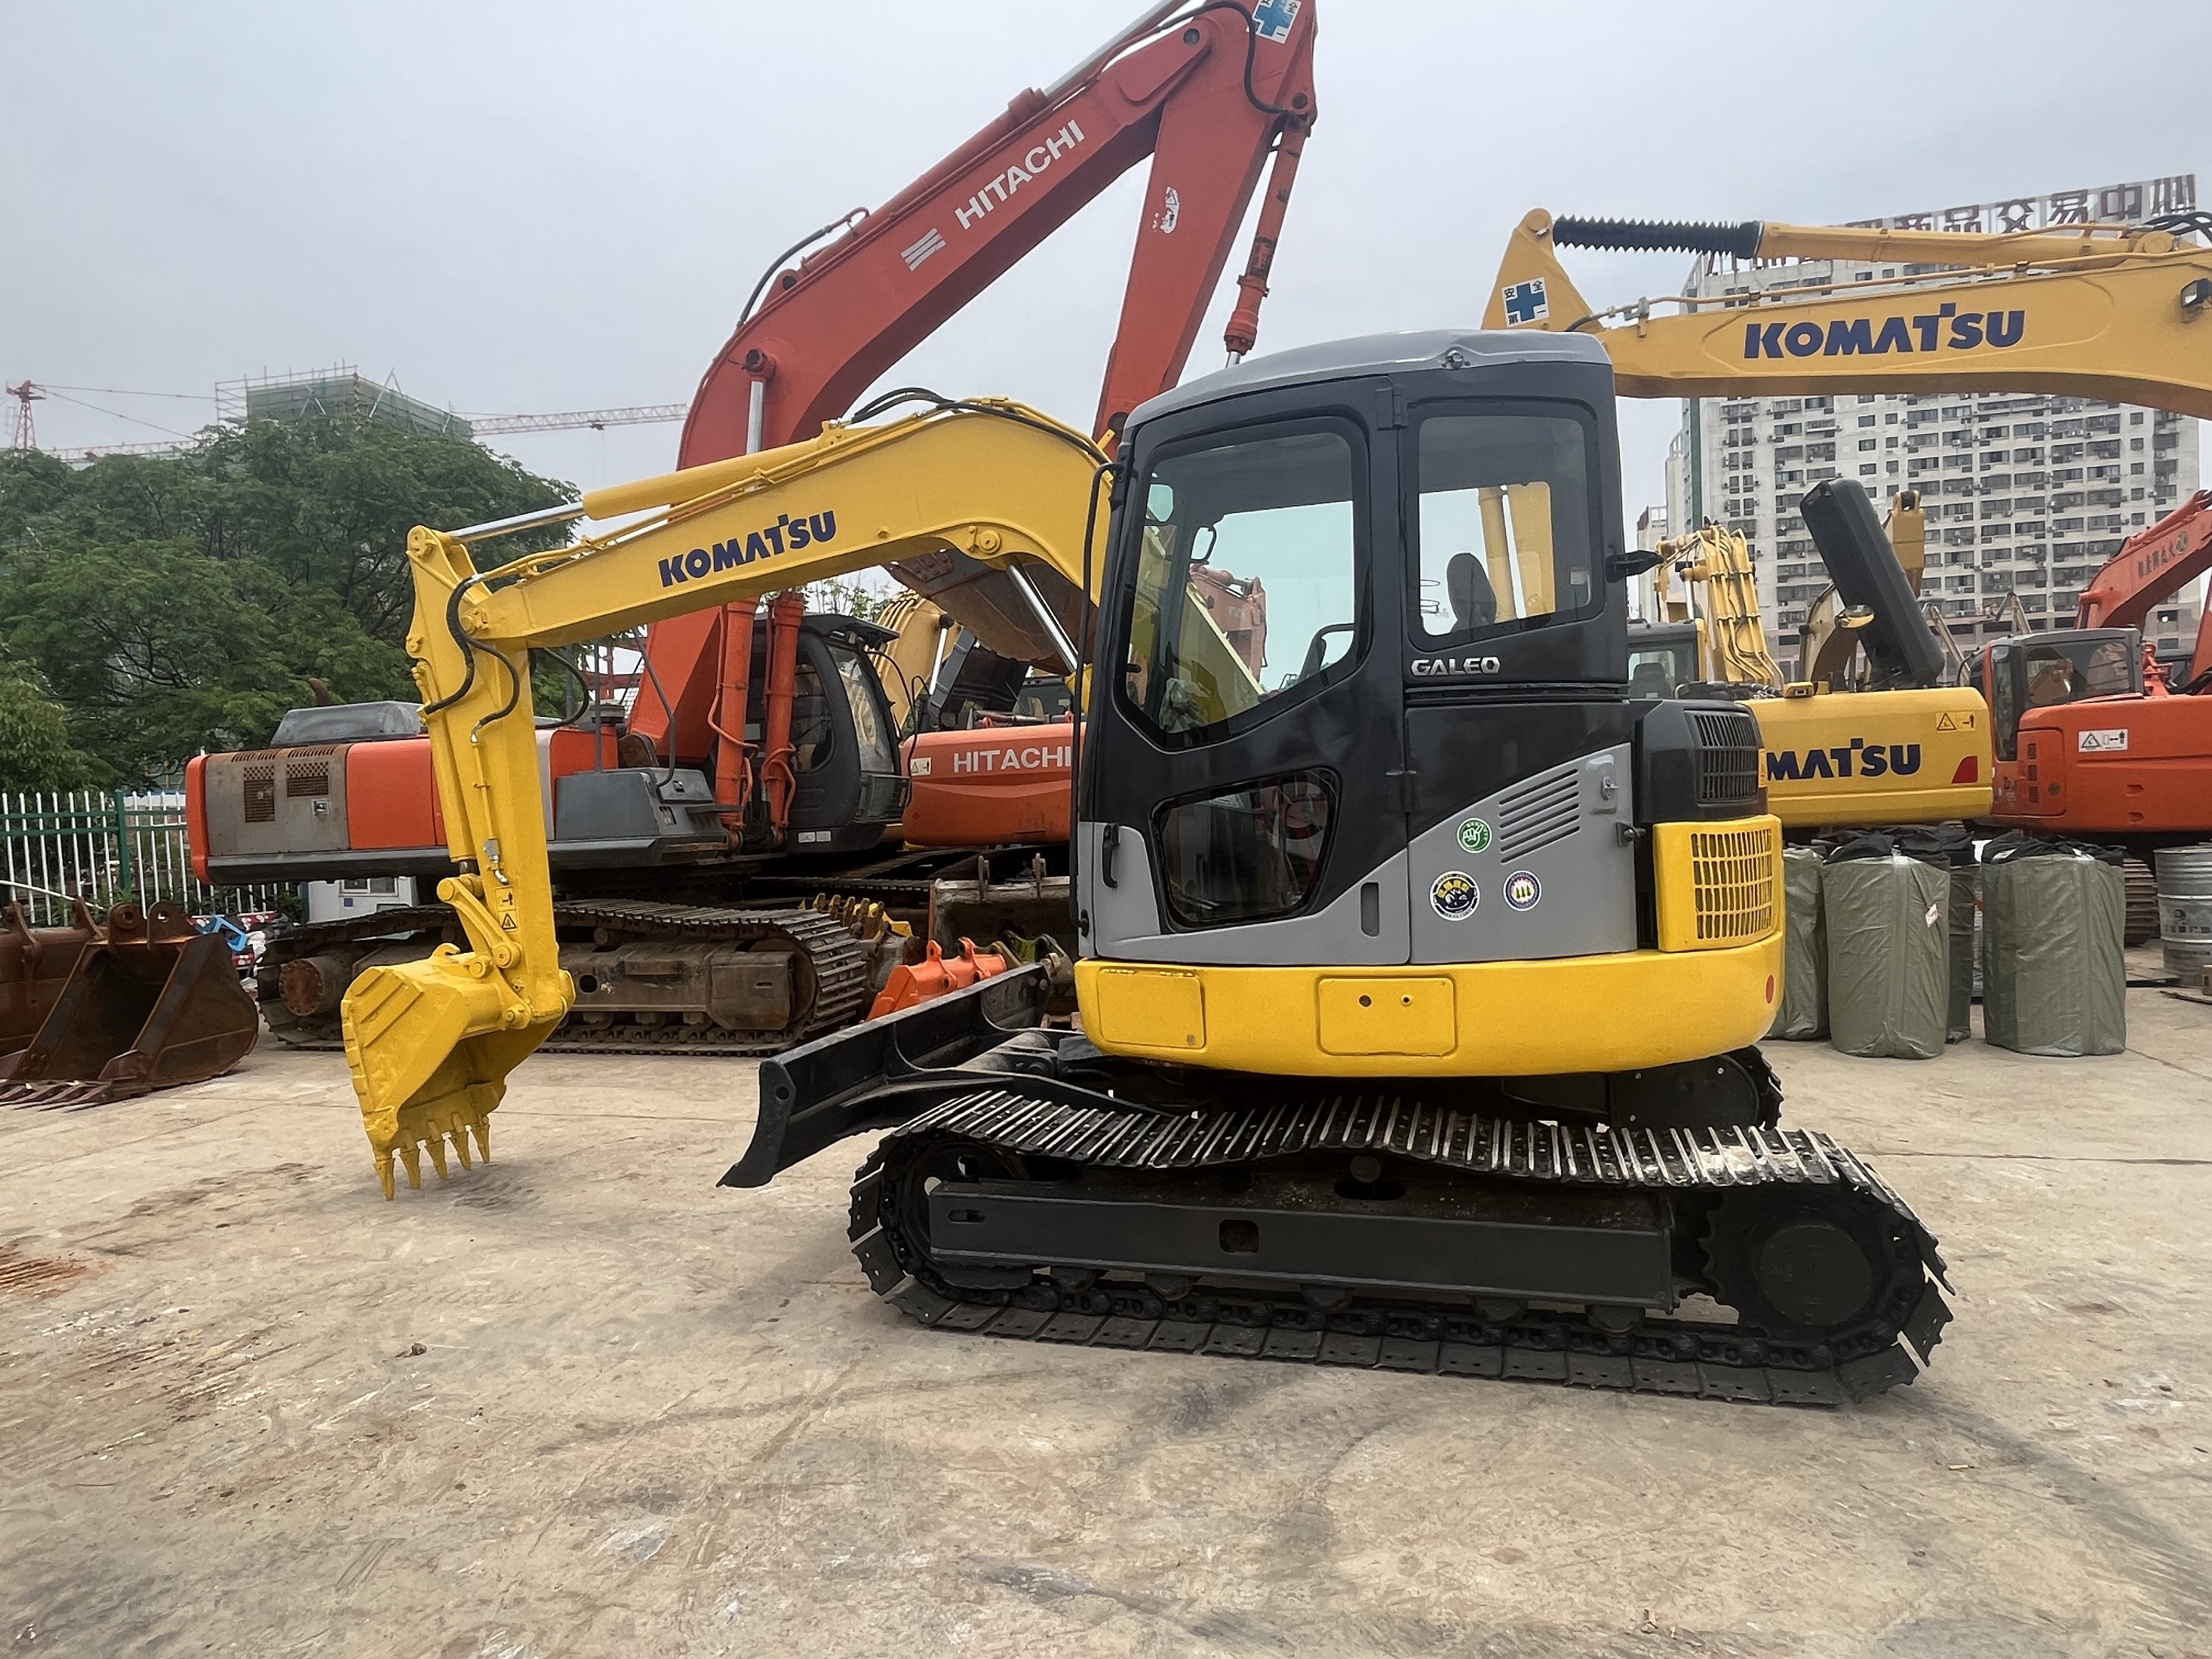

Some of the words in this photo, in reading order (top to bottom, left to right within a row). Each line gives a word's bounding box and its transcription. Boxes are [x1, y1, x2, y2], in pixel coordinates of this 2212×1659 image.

[955, 119, 1085, 230] HITACHI
[1743, 303, 2025, 359] KOMATSU
[658, 510, 837, 588] KOMATSU
[1411, 657, 1500, 676] GALEO
[953, 746, 1071, 772] HITACHI
